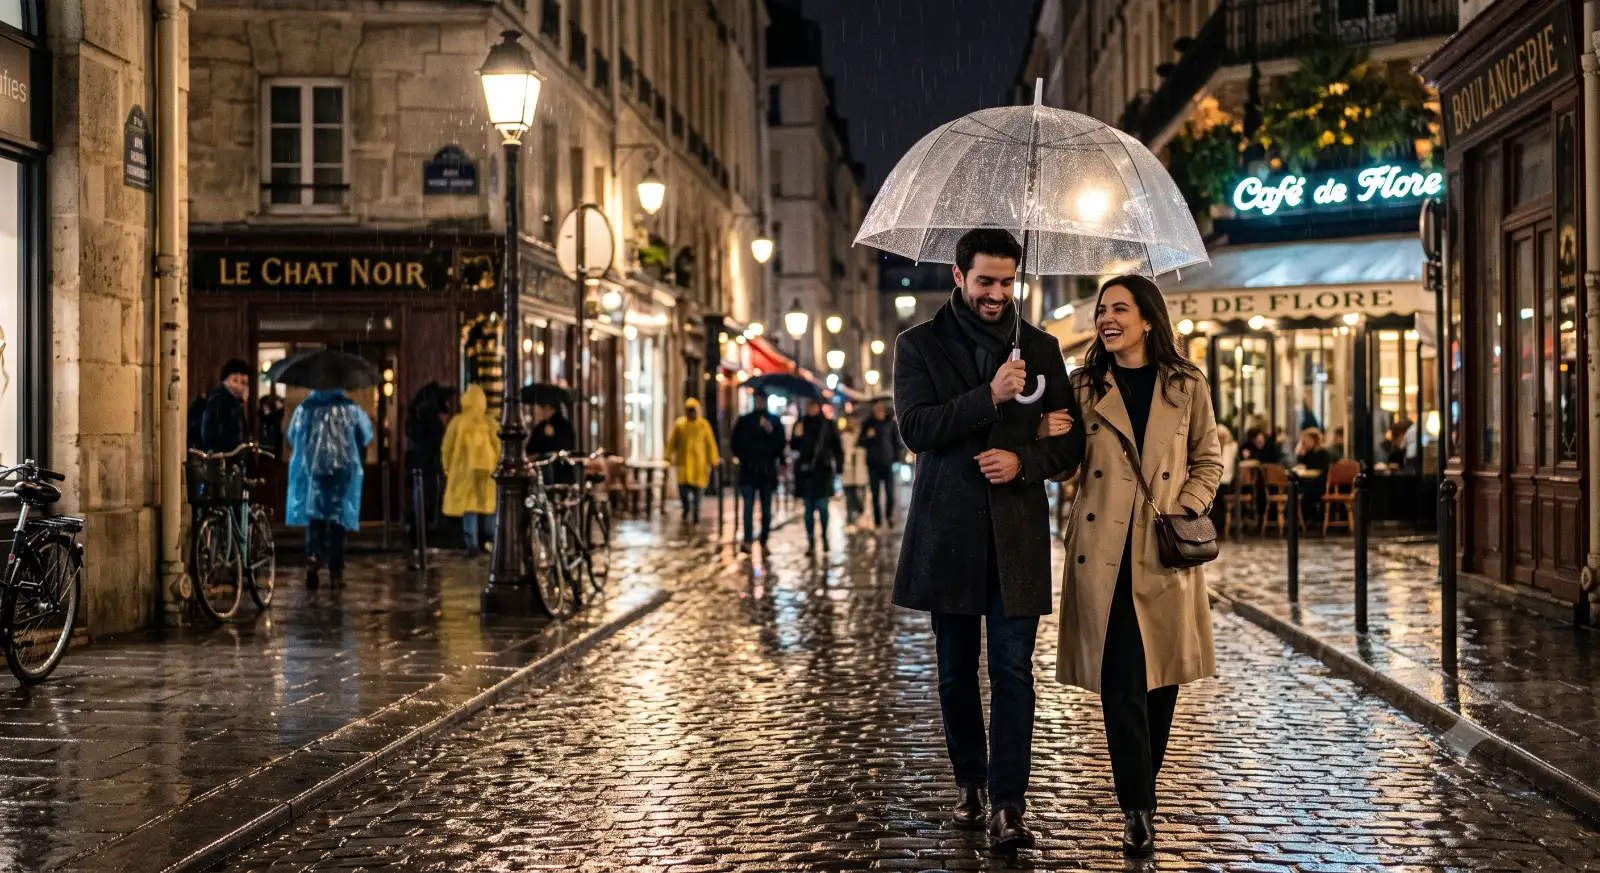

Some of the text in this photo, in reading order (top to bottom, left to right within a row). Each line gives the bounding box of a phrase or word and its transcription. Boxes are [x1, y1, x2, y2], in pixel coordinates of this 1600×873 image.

[1452, 24, 1558, 135] BOULANGERIE
[1233, 165, 1443, 216] Café de Flore
[1211, 295, 1254, 314] DE
[1269, 289, 1393, 312] FLORE
